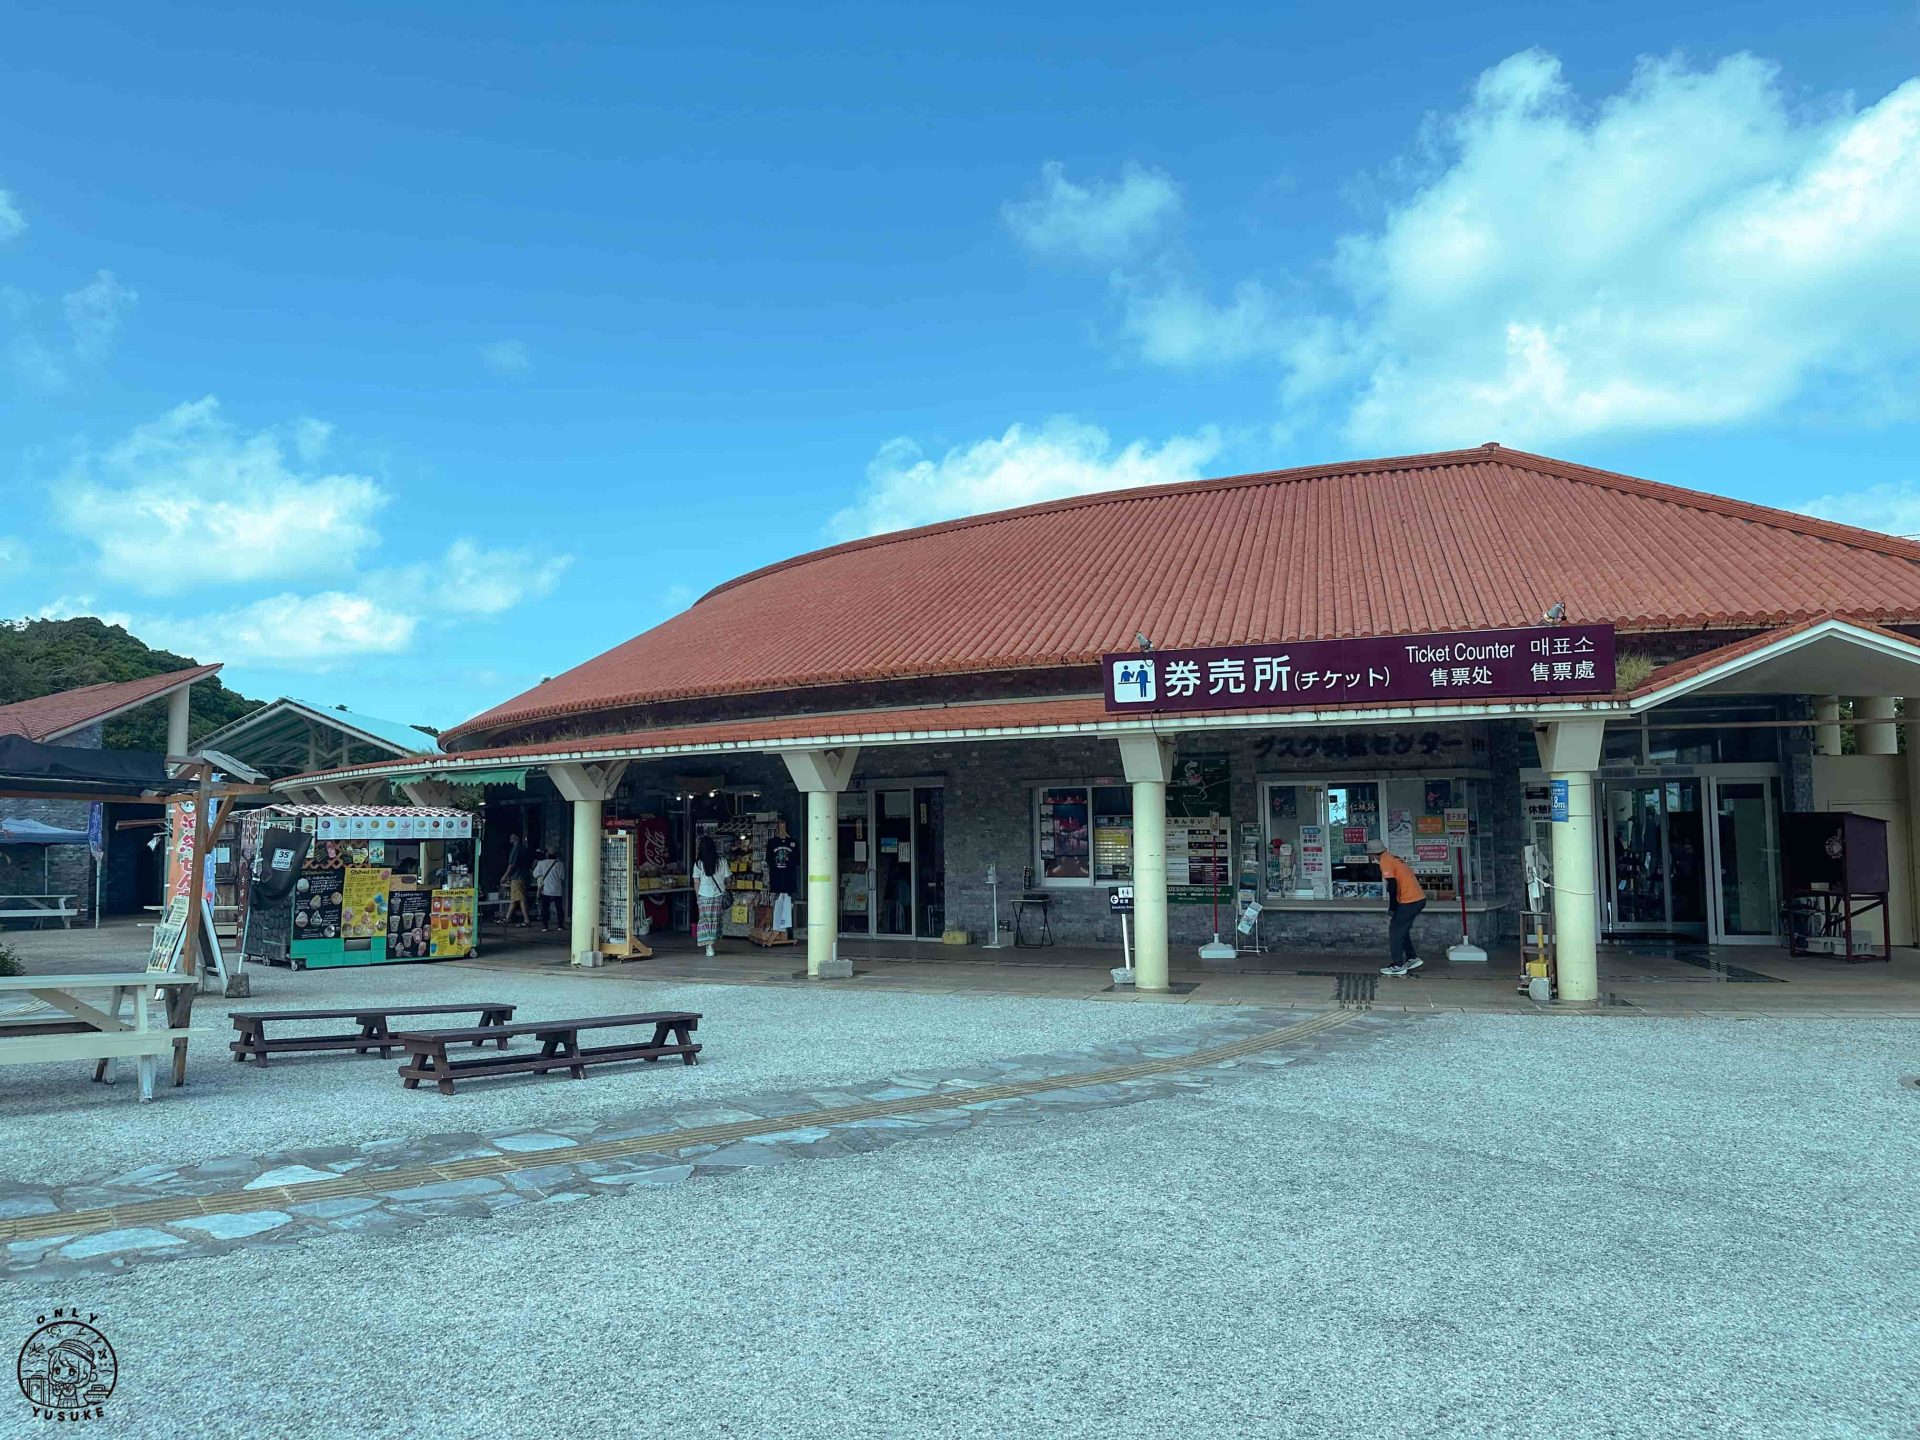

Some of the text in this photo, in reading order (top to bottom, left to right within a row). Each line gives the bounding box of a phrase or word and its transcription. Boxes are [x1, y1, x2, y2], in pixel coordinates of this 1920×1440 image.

[1405, 642, 1515, 664] Ticket Counter
[1530, 636, 1595, 657] 매표소
[1429, 665, 1493, 687] 售票处
[1530, 660, 1596, 682] 售票處
[278, 850, 290, 858] 35
